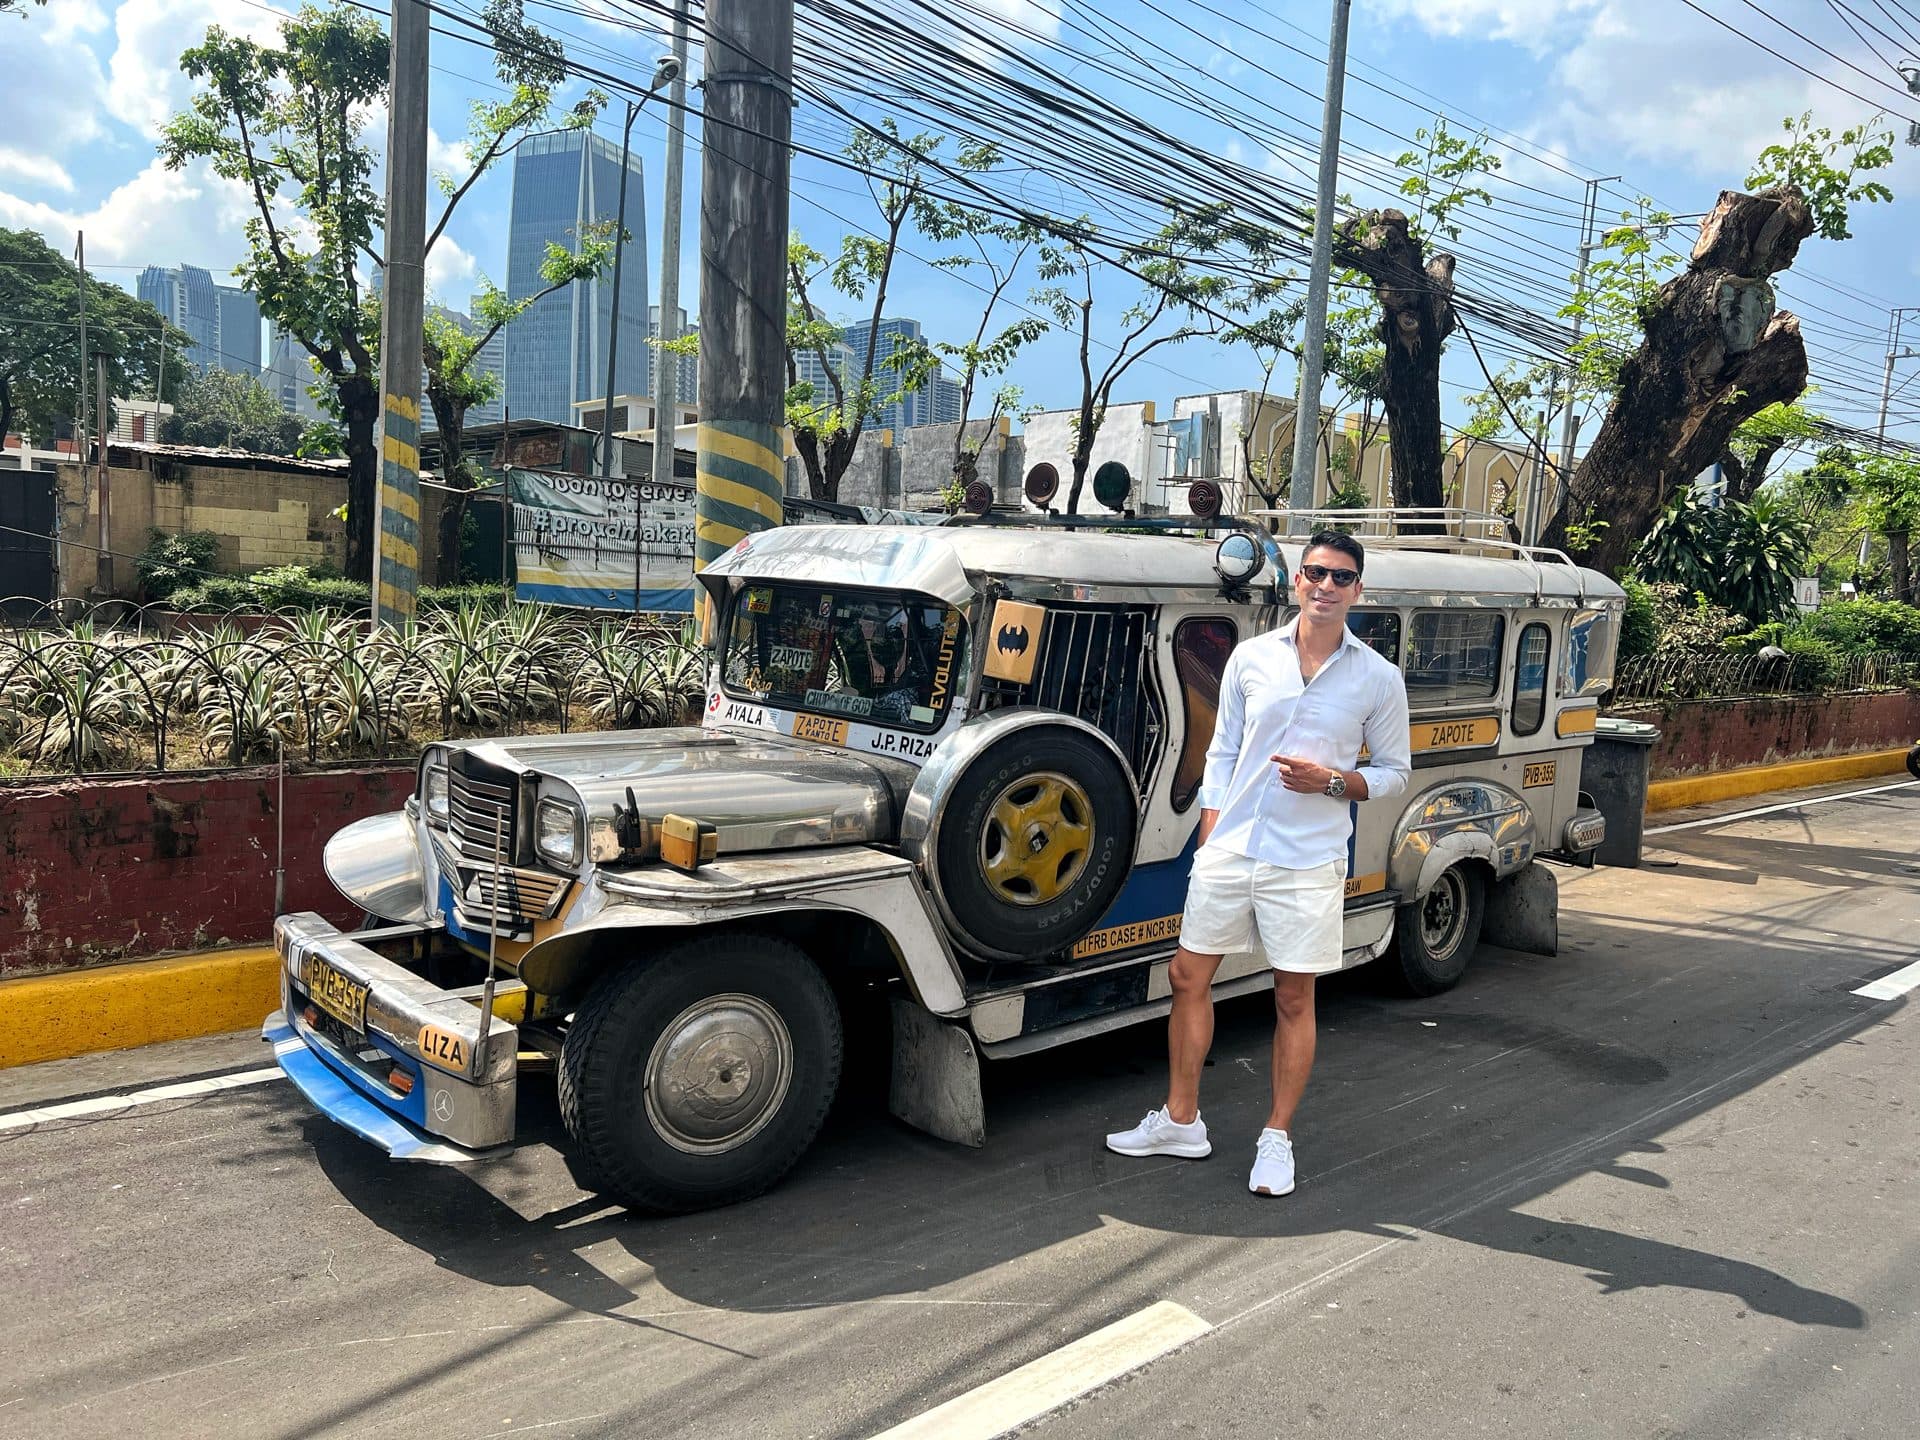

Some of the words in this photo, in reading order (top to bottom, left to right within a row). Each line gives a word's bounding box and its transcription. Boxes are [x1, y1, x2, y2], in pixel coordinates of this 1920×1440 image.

[602, 479, 625, 498] to
[630, 482, 686, 501] serve
[533, 508, 696, 544] #proudmakati
[771, 648, 812, 669] ZAPOTE
[725, 703, 763, 726] AYALA
[796, 715, 843, 742] ZAPOTE
[1431, 723, 1475, 746] ZAPOTE
[871, 732, 896, 751] J.P.
[899, 735, 938, 758] RIZA
[1524, 764, 1554, 785] PVB-355
[1038, 836, 1114, 929] GOODYEAR
[1077, 932, 1107, 954] LTFRB
[1110, 926, 1136, 946] CASE
[1138, 923, 1144, 940] #
[1146, 920, 1165, 939] NCR
[424, 1030, 464, 1066] LIZA
